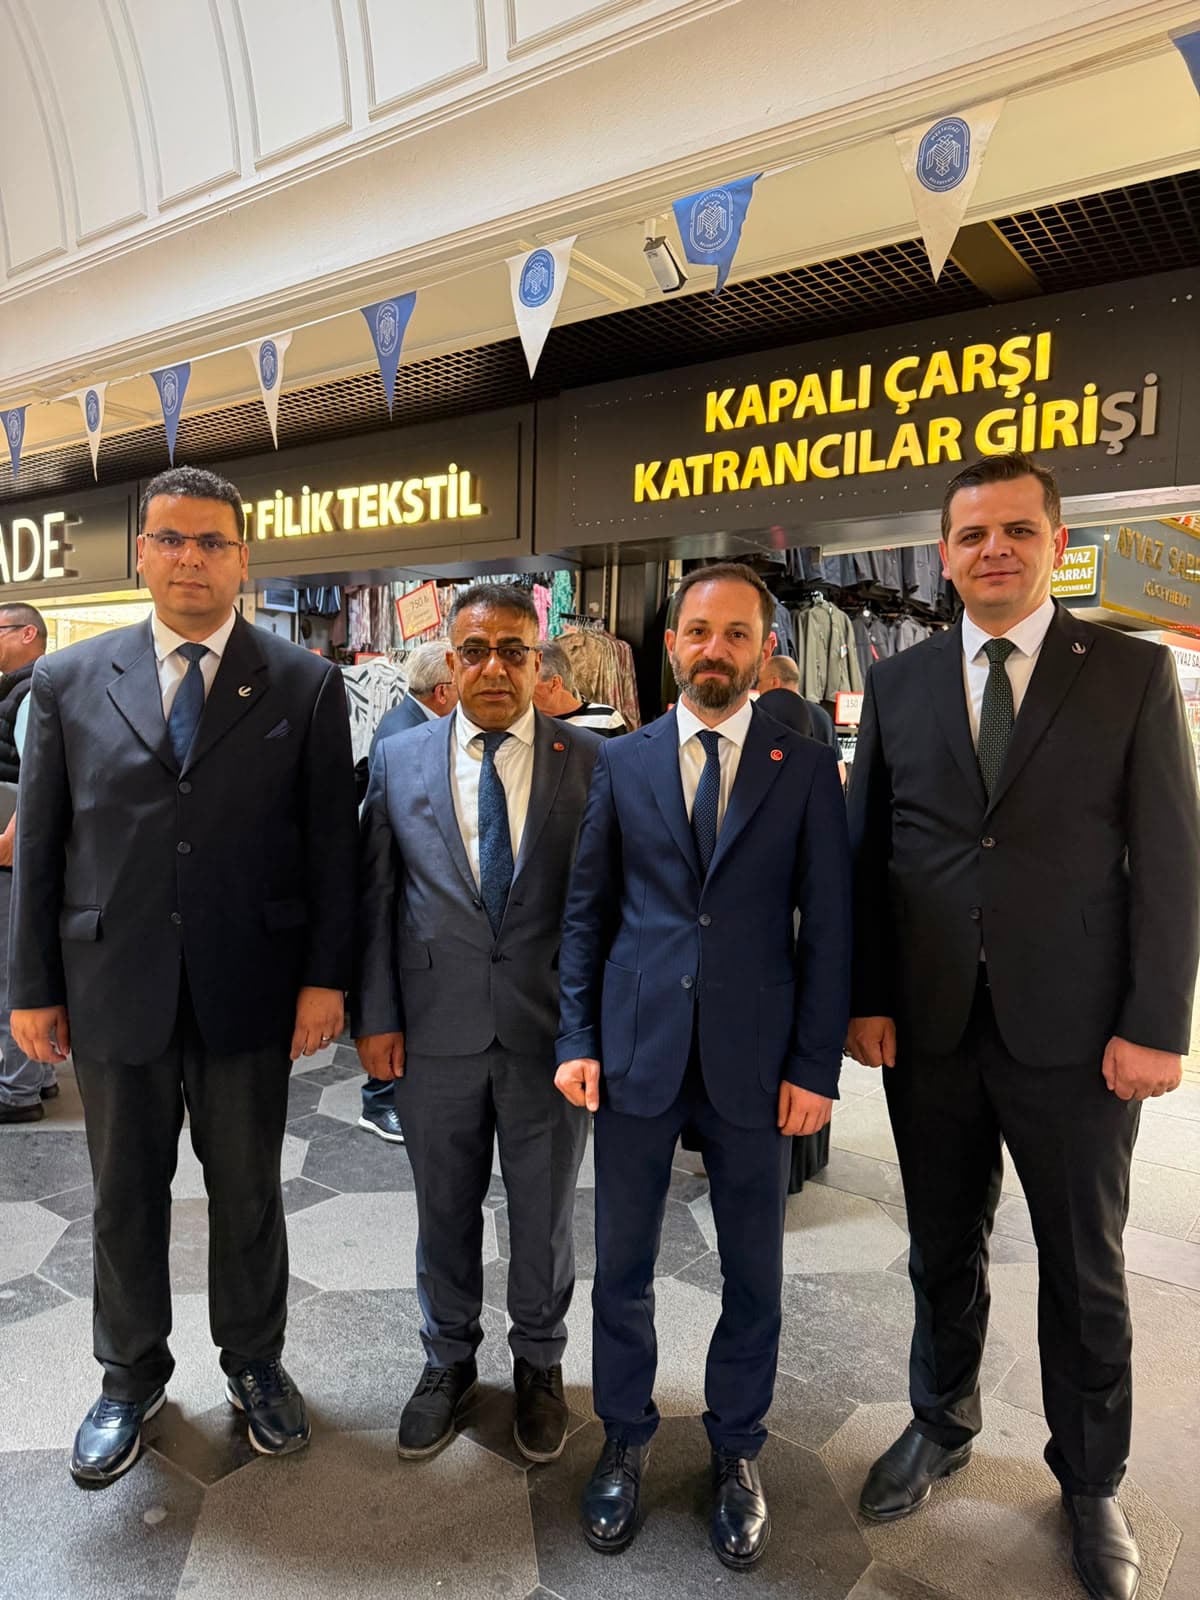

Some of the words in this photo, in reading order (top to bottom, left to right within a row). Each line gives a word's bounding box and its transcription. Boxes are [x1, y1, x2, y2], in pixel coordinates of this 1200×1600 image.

[705, 364, 872, 433] KAPALI
[884, 331, 1051, 415] ÇARŞI
[634, 417, 962, 503] KATRANCILAR
[974, 372, 1159, 456] GİRİŞİ
[257, 489, 334, 540] FİLİK
[336, 462, 482, 530] TEKSTİL
[1051, 566, 1094, 582] SARRAF
[1063, 551, 1091, 566] YVAZ
